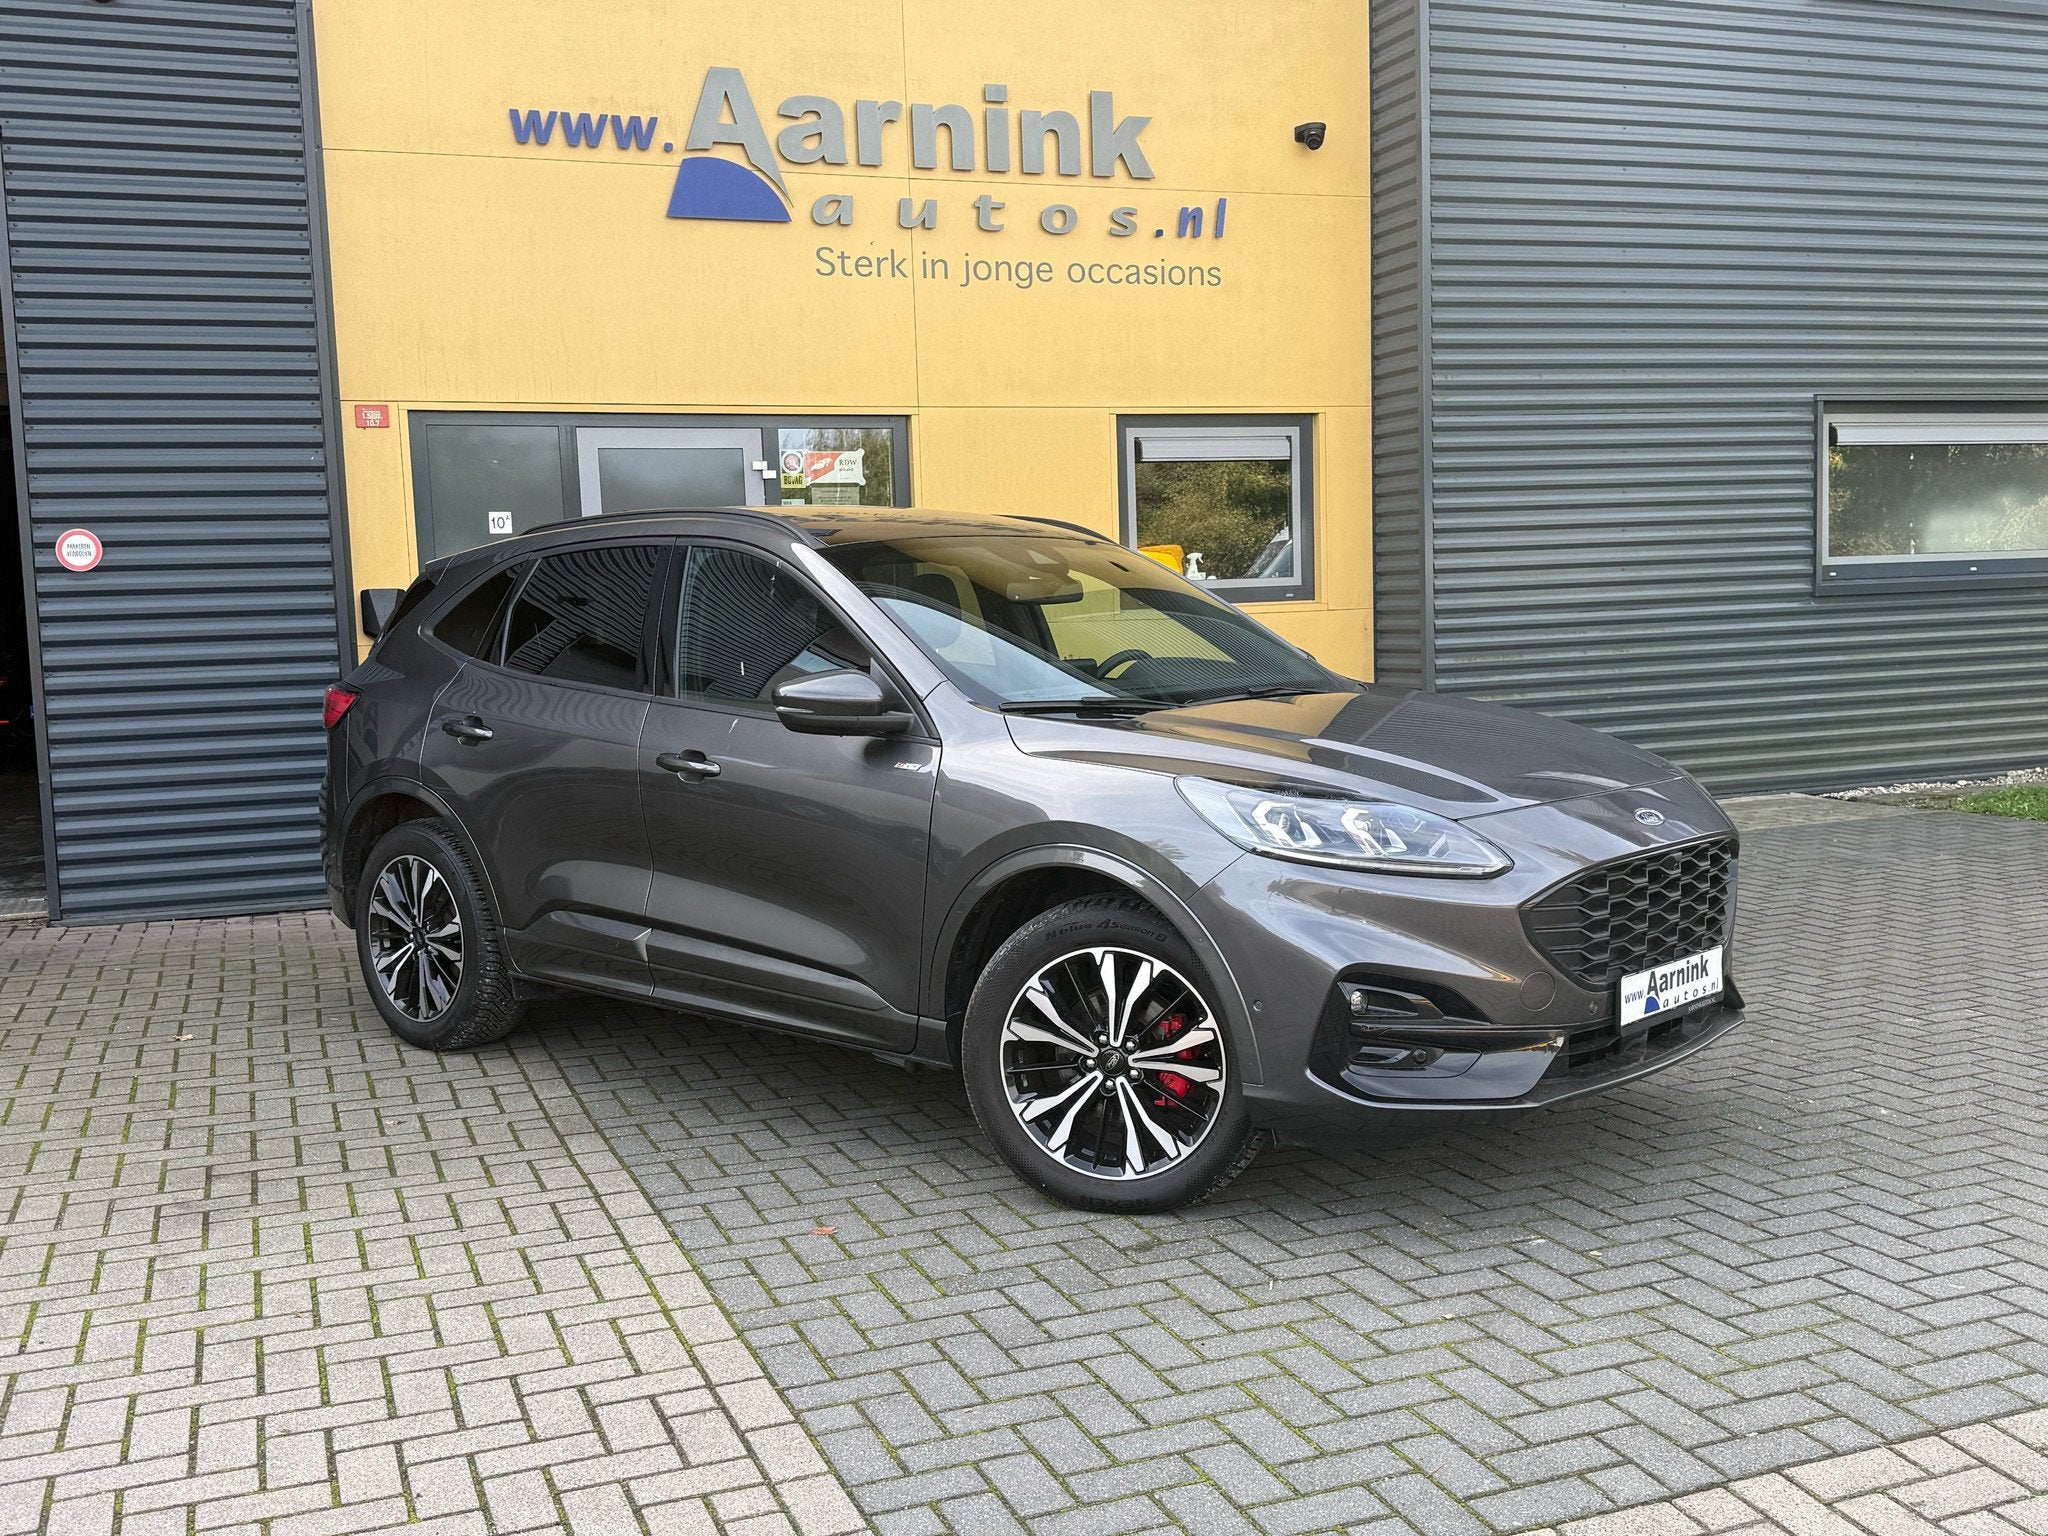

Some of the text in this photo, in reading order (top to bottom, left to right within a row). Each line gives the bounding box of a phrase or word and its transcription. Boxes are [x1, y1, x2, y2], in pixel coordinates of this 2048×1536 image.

[815, 246, 1223, 289] Sterk in jonge occasions
[783, 475, 803, 485] BOVAG
